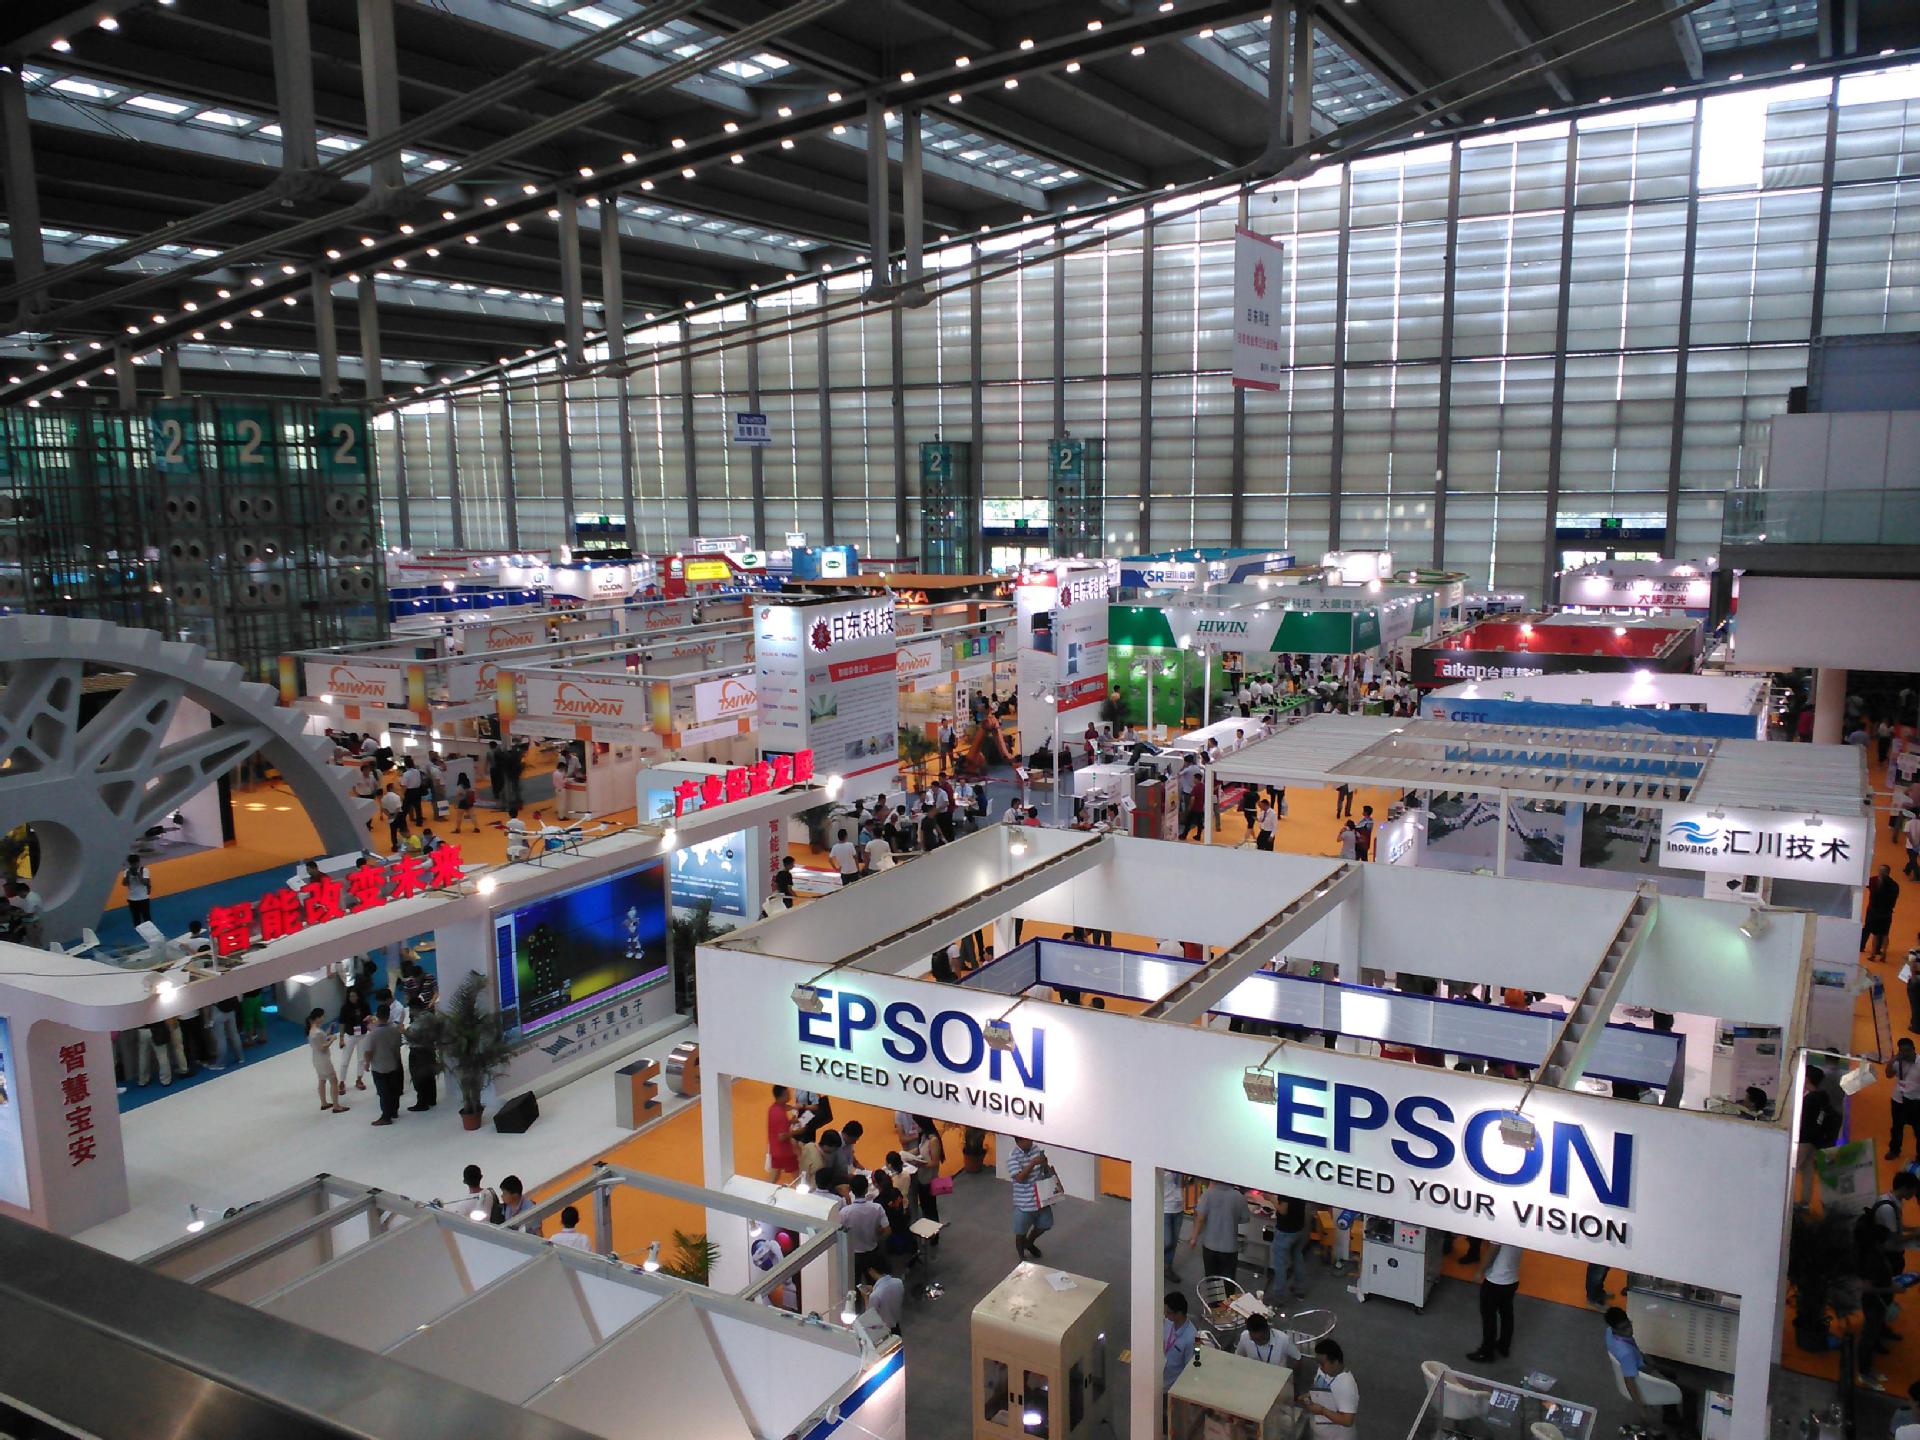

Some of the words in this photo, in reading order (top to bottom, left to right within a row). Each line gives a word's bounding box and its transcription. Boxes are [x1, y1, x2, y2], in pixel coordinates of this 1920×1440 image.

[162, 419, 183, 463] 2
[237, 419, 264, 463] 2
[332, 422, 357, 464] 2
[1060, 448, 1072, 470] 2
[930, 451, 942, 472] 2
[485, 626, 534, 649] TAIWAN
[833, 607, 894, 642] 日东科技
[1197, 620, 1249, 633] HIWIN
[327, 666, 386, 697] TAIWAN
[553, 682, 623, 716] TAIWAN
[1450, 711, 1488, 723] CETC
[1667, 841, 1718, 856] Inovance
[1723, 829, 1850, 863] 汇川技术
[208, 843, 465, 957] 智能改变未来
[798, 984, 1046, 1091] EPSON
[59, 1040, 97, 1167] 智慧宝安
[800, 1054, 889, 1087] EXCEED
[898, 1073, 961, 1103] YOUR
[966, 1087, 1044, 1121] VISION
[1276, 1072, 1633, 1209] EPSON
[1274, 1150, 1395, 1195] EXCEED
[1408, 1178, 1495, 1217] YOUR
[1512, 1200, 1628, 1245] VISION
